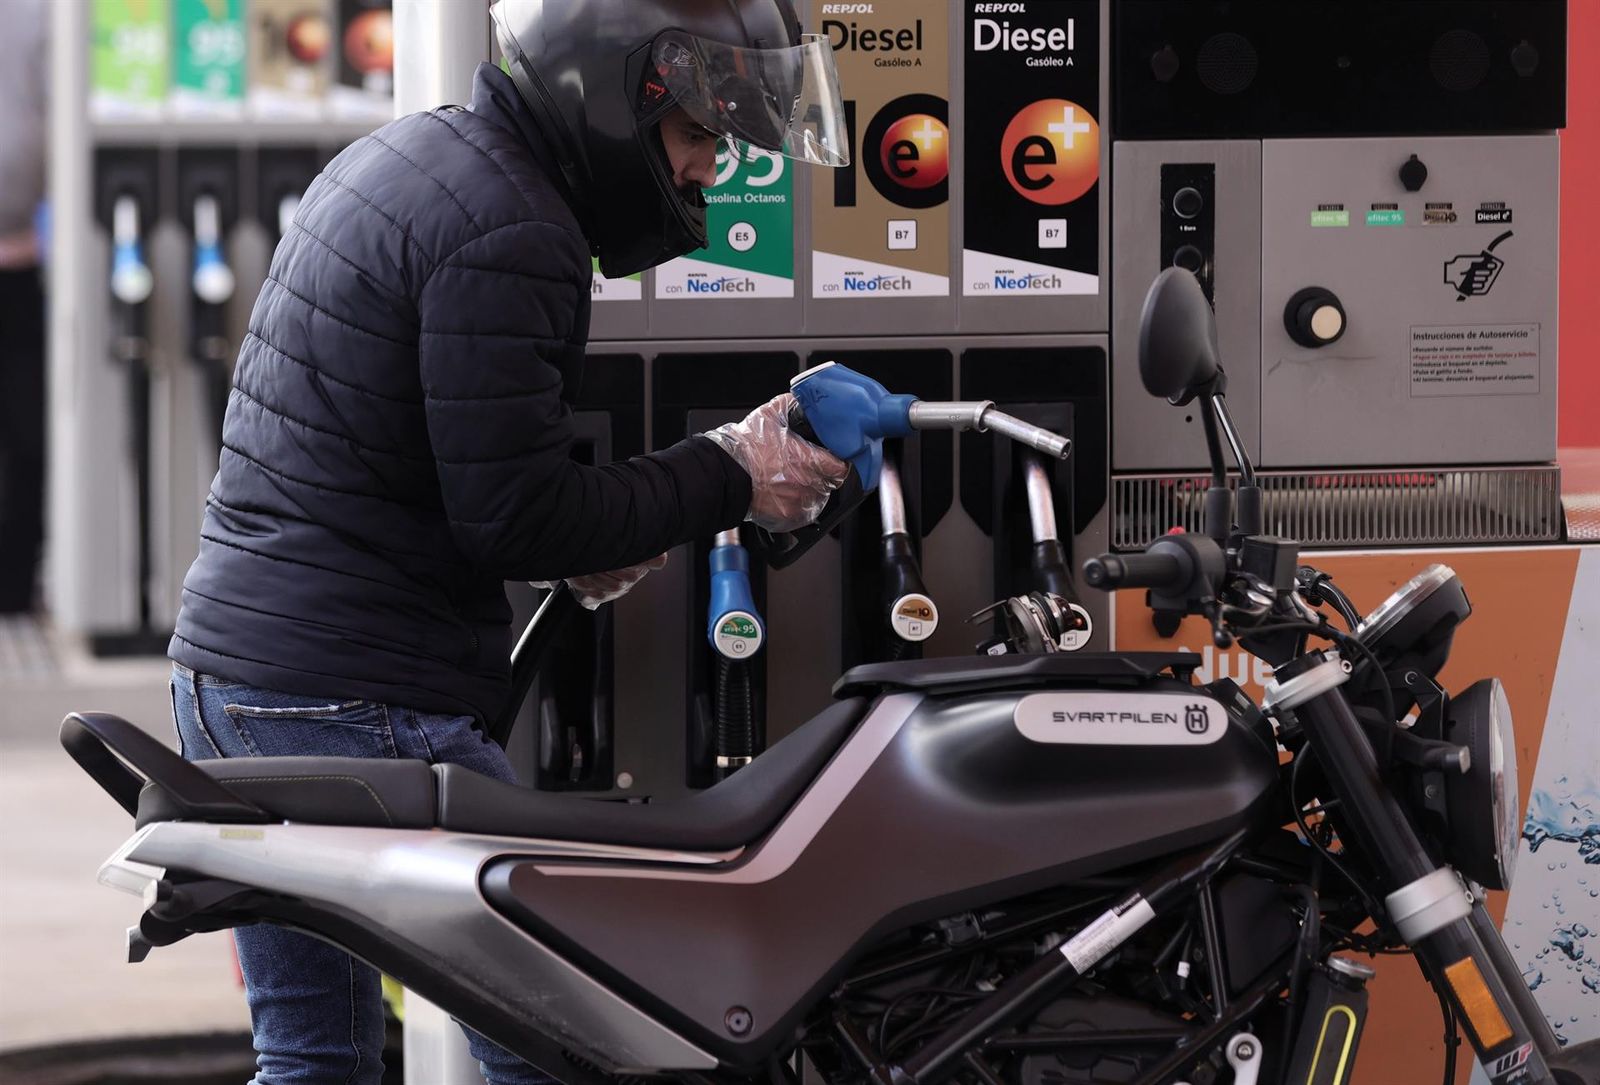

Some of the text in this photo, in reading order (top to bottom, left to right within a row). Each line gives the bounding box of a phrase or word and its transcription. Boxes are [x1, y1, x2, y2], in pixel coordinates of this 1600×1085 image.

[822, 4, 873, 13] REPSOL
[974, 3, 1026, 13] REPSOL
[822, 20, 922, 51] Diesel
[974, 18, 1074, 51] Diesel
[874, 57, 922, 67] Gasóleo A
[1026, 57, 1074, 67] Gasóleo A
[744, 193, 786, 203] Octanos
[1477, 212, 1500, 221] Diesel
[735, 232, 749, 241] E5
[895, 230, 909, 240] B7
[1046, 228, 1059, 238] B7
[666, 277, 755, 293] con NeoTech
[823, 275, 912, 292] con NeoTech
[973, 274, 1062, 290] con NeoTech
[1413, 330, 1529, 340] Instrucciones de Autoservicio
[742, 624, 755, 633] 95
[1052, 711, 1178, 724] SVARTPILEN
